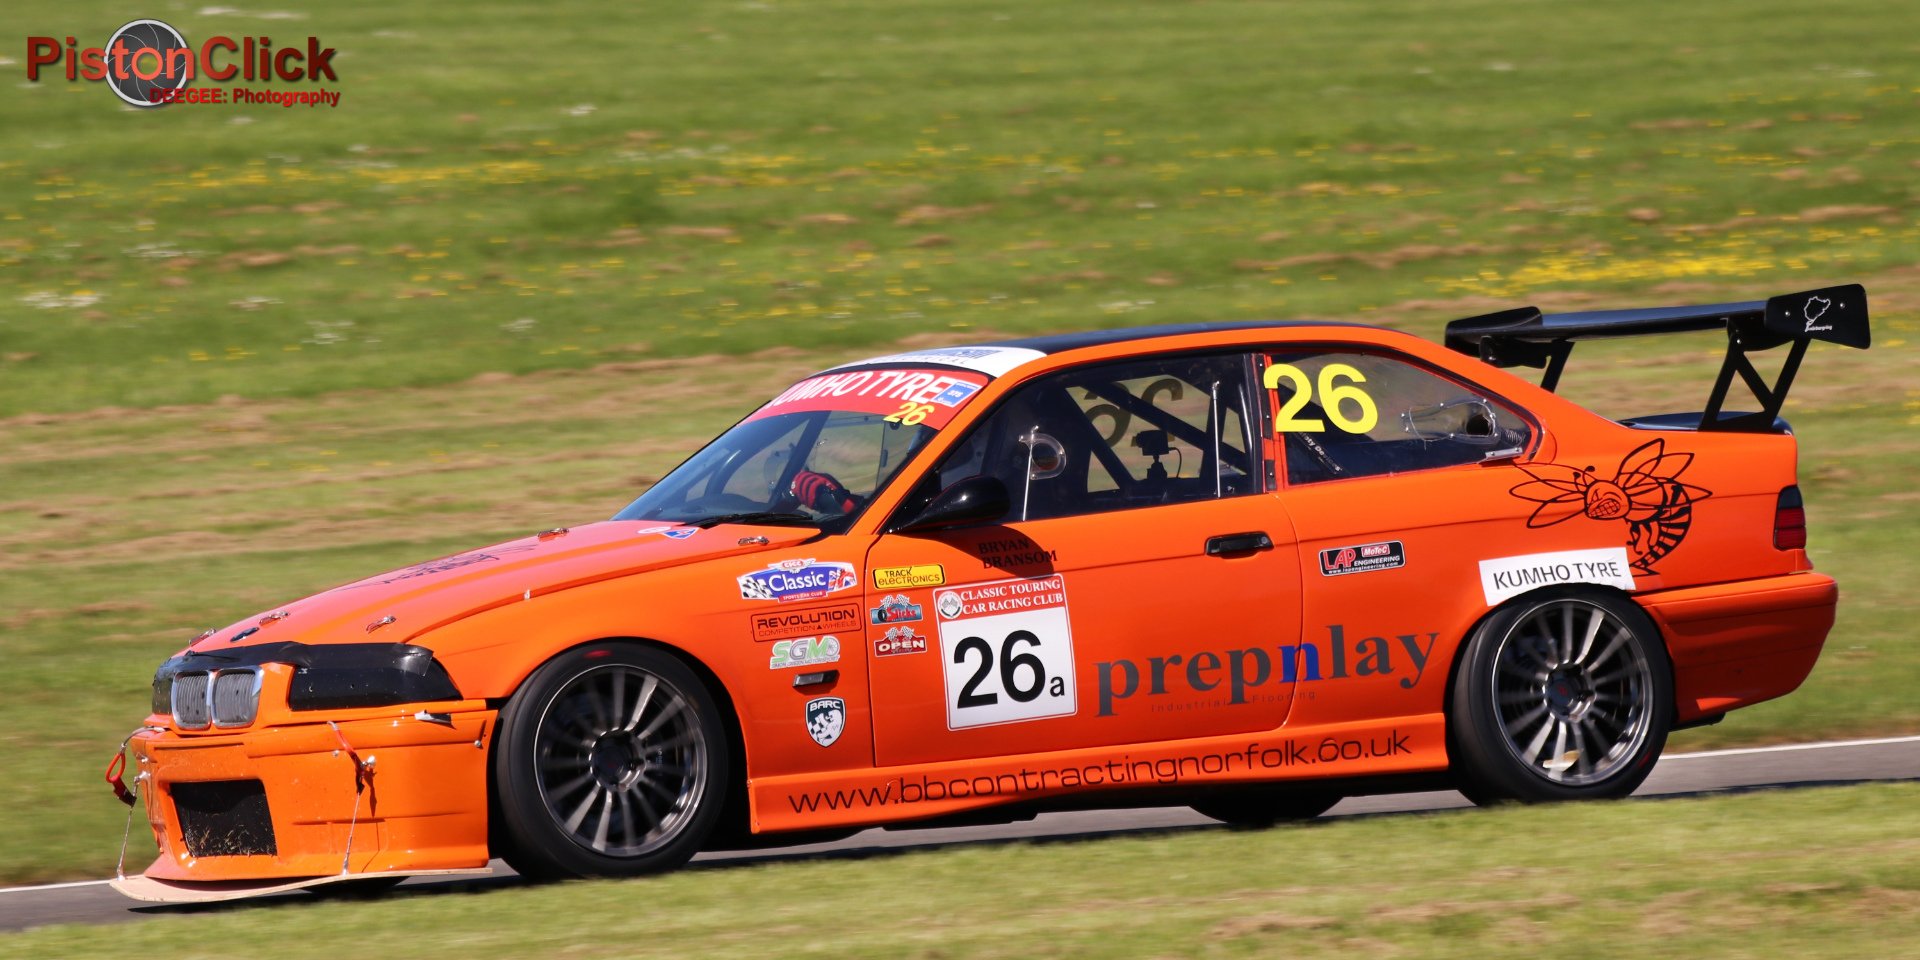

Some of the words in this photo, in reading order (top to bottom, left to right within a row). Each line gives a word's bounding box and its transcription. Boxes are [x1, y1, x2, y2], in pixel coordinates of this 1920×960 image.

[857, 371, 953, 404] TYRE
[1263, 362, 1378, 435] 26
[883, 402, 935, 427] 26
[979, 539, 1030, 555] BRYAN
[982, 550, 1057, 569] BRANSOM
[1322, 548, 1356, 571] LAP
[1353, 555, 1400, 567] ENGINEERING
[768, 572, 827, 592] Classic
[884, 567, 912, 578] TRACK
[1493, 564, 1571, 590] KUMHO
[1573, 562, 1622, 579] TYRE
[960, 586, 1008, 601] CLASSIC
[1009, 579, 1061, 595] TOURING
[962, 602, 987, 615] CAR
[988, 597, 1032, 612] RACING
[1033, 592, 1064, 606] CLUB
[757, 608, 855, 630] REVOLUTION
[758, 625, 816, 637] COMPETITION
[822, 620, 857, 630] WHEELS
[878, 640, 925, 652] OPEN
[1094, 624, 1440, 718] prepnlay
[809, 700, 841, 712] BARC
